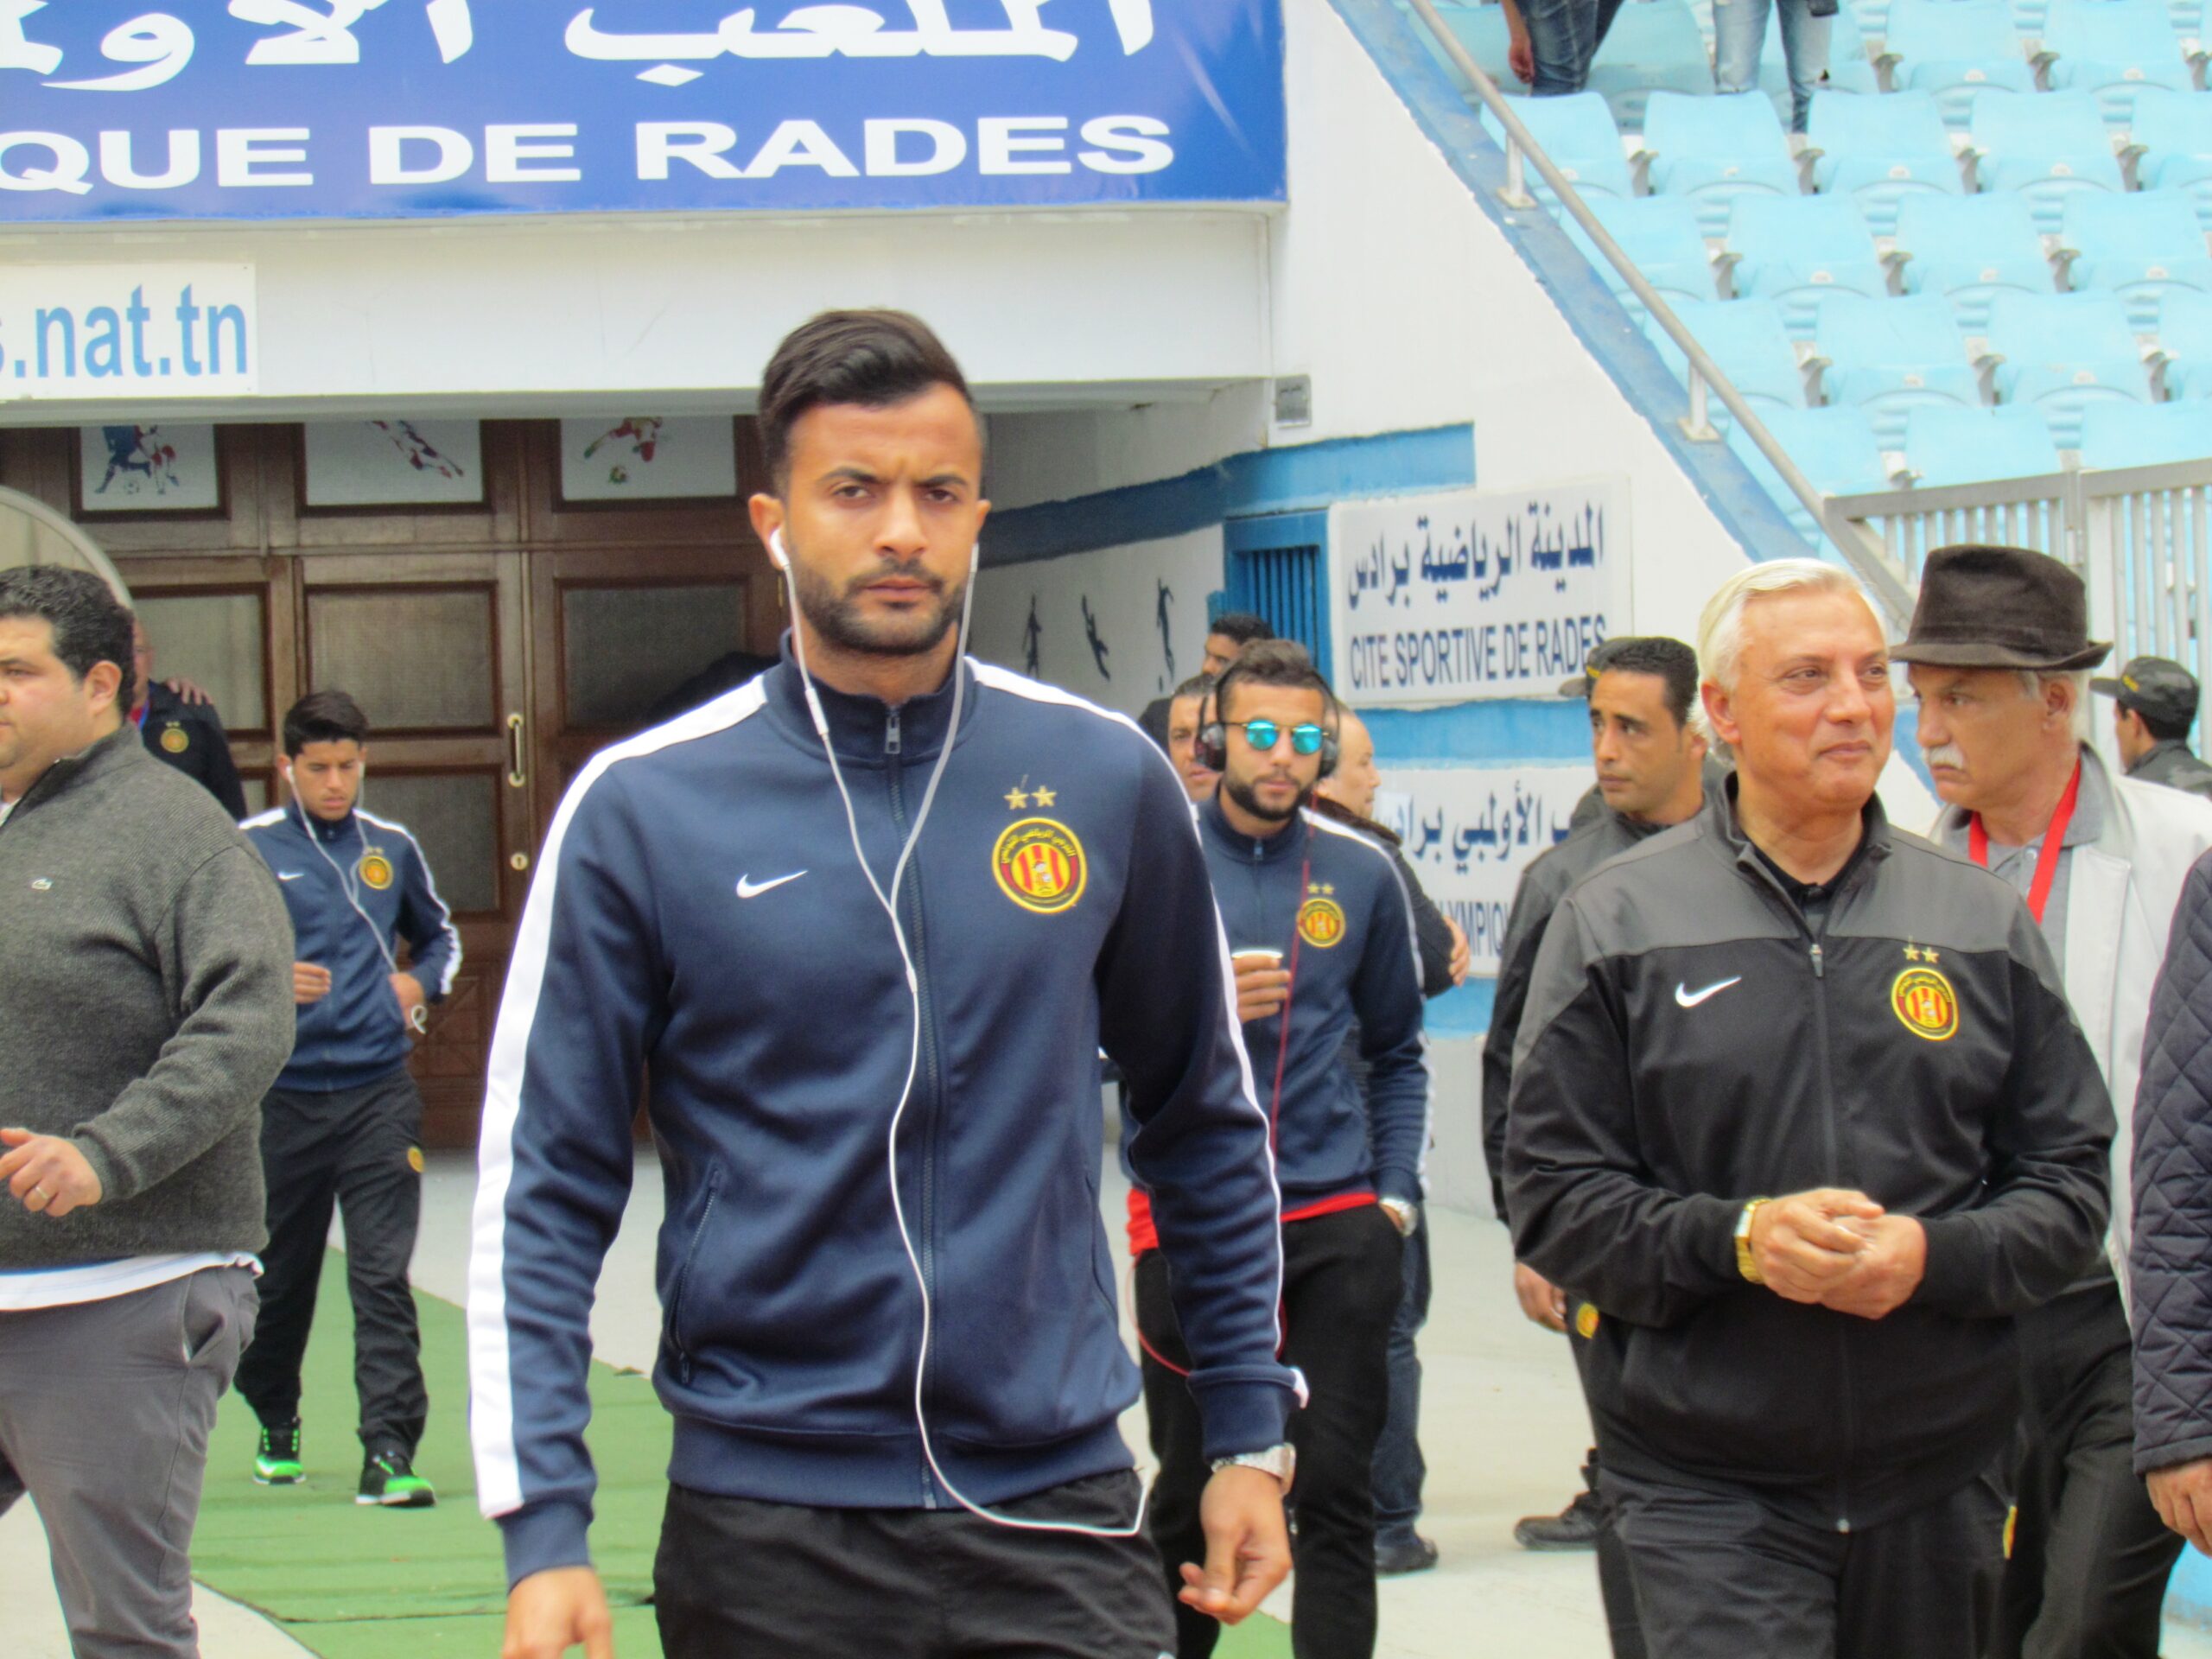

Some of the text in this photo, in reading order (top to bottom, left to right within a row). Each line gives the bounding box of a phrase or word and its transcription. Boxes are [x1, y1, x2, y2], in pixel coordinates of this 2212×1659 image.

[0, 115, 1174, 195] QUE DE RADES
[0, 283, 248, 378] .nat.tn
[1348, 500, 1604, 610] المدينة الرياضية برادس
[1350, 633, 1390, 690] CITE
[1395, 625, 1497, 689] SPORTIVE
[1503, 621, 1530, 679] DE
